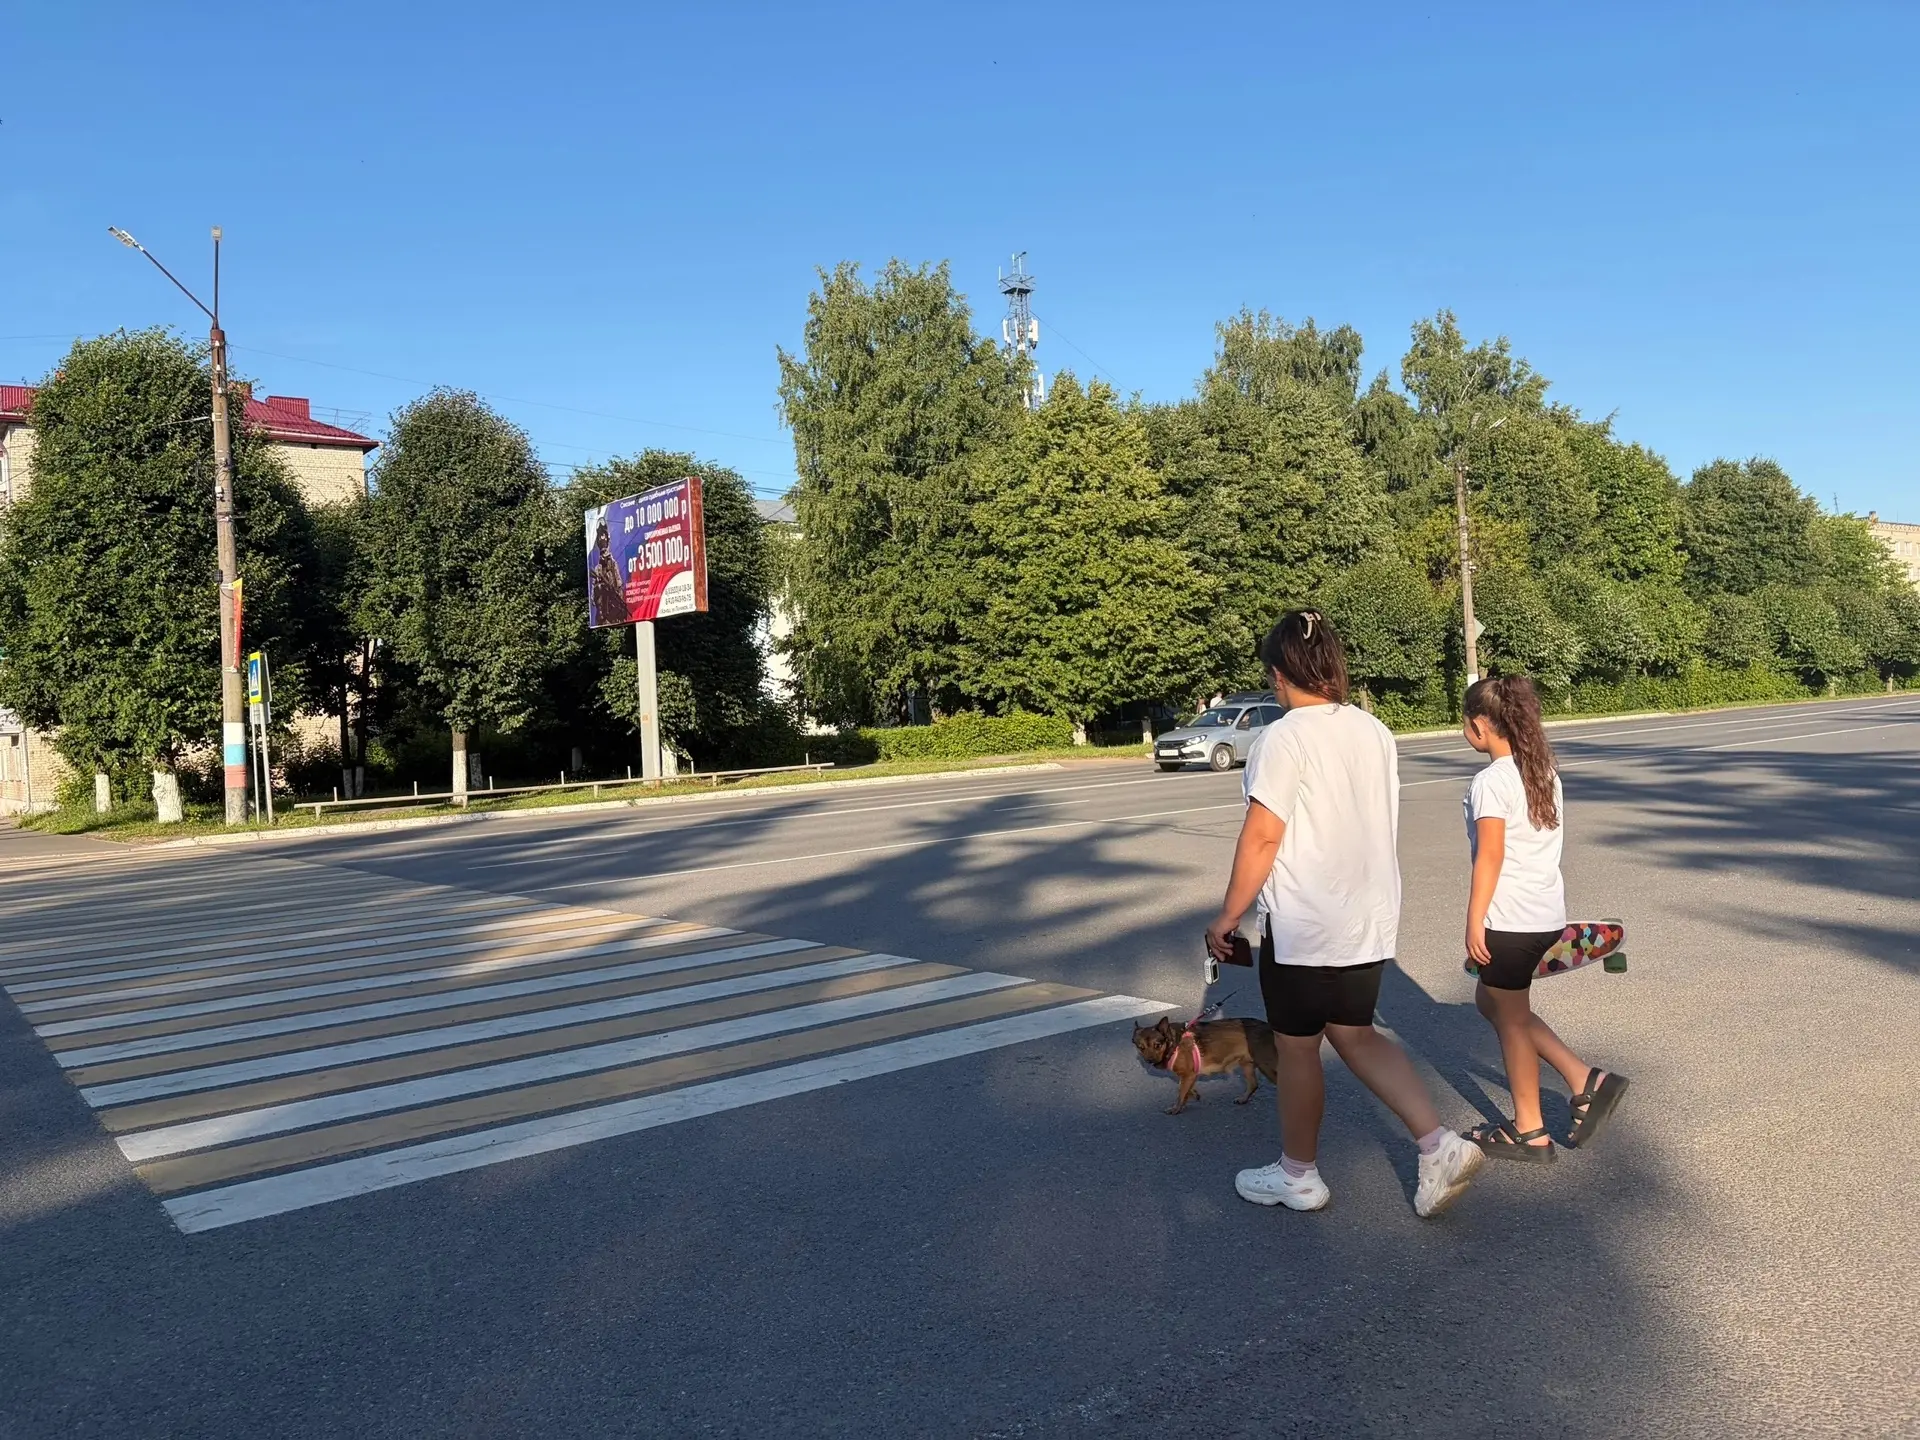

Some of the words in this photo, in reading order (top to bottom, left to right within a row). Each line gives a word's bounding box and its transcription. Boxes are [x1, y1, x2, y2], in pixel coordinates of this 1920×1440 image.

[624, 515, 634, 534] до
[636, 506, 645, 528] 10
[647, 501, 662, 525] 000
[664, 496, 679, 520] 000
[628, 557, 637, 573] от
[638, 544, 645, 571] 3
[645, 540, 663, 570] 500
[665, 535, 683, 565] 000
